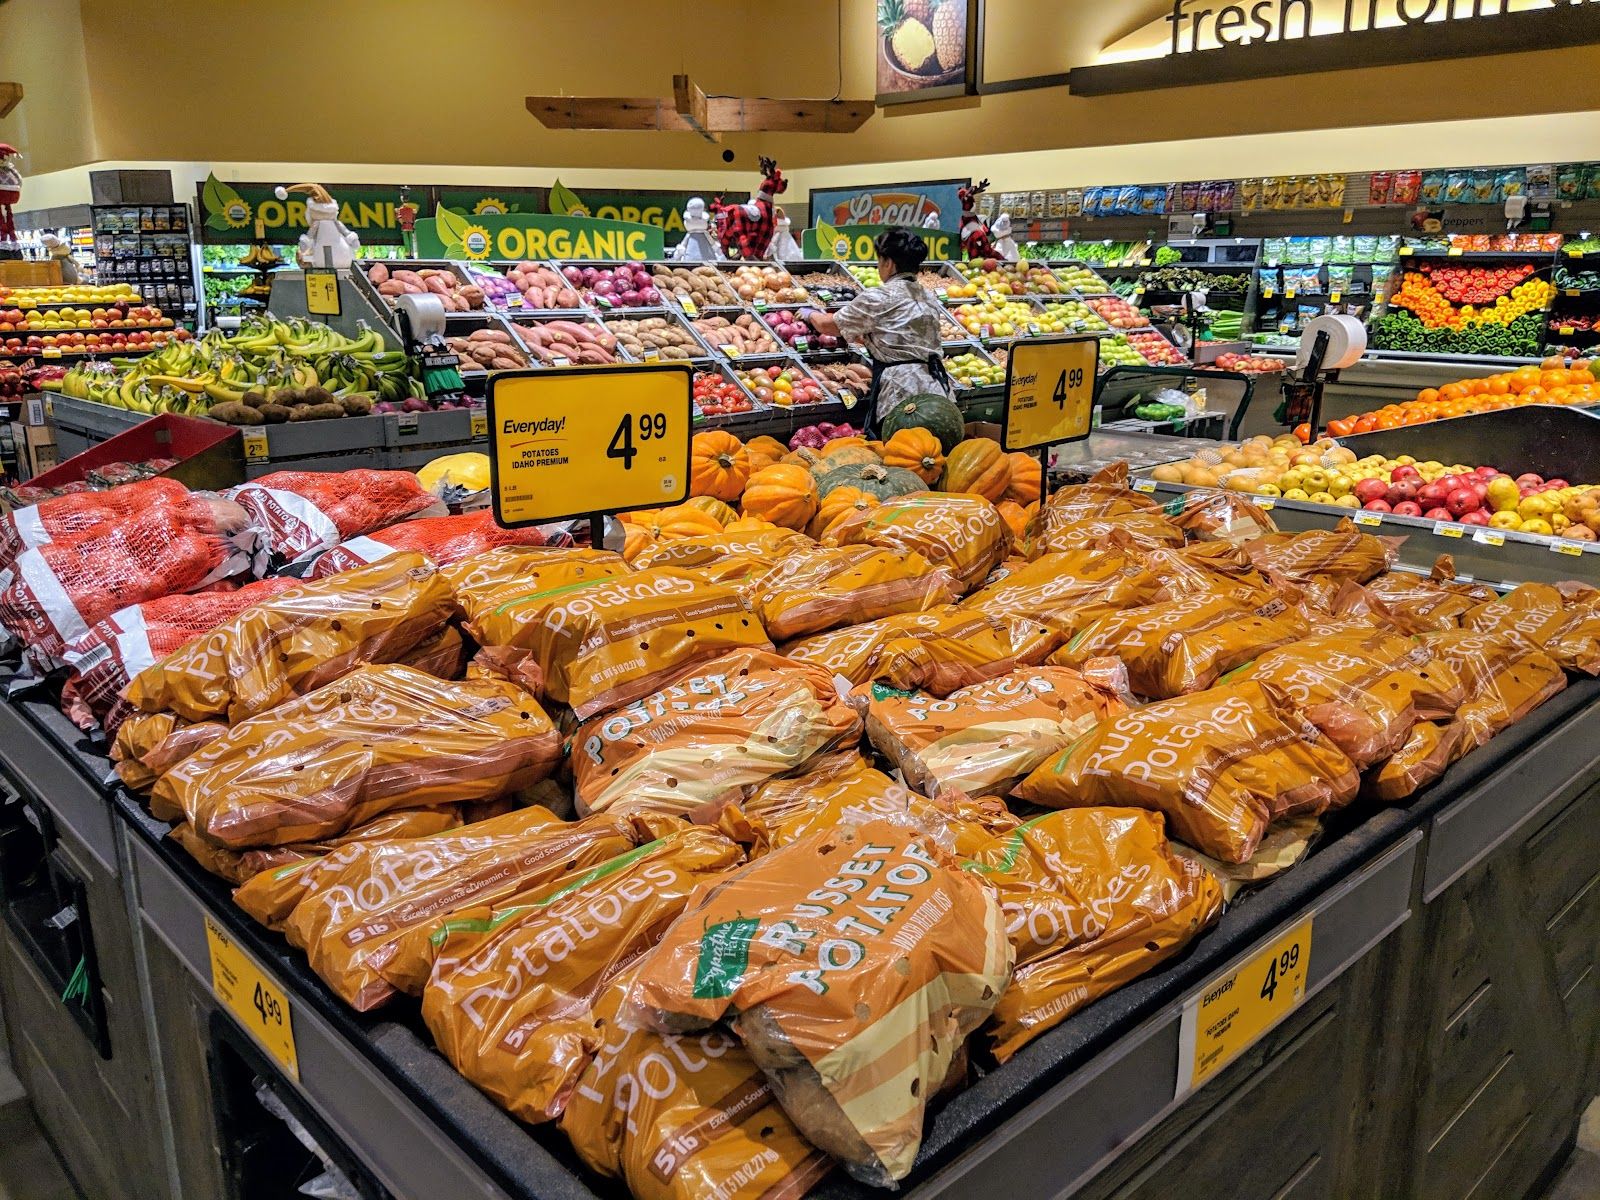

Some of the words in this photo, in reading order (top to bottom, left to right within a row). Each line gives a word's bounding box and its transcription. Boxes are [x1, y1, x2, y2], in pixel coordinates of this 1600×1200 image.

[1165, 0, 1313, 56] fresh
[257, 200, 420, 230] ORANI
[846, 193, 927, 227] Local
[1443, 216, 1485, 227] peppers
[497, 227, 648, 261] ORGANIC
[503, 416, 566, 436] Everyday!
[512, 459, 535, 469] IDAHO
[536, 457, 569, 467] PREMIUM
[521, 448, 559, 459] POTATOES
[524, 851, 546, 867] Good
[545, 840, 570, 858] Source
[402, 902, 439, 923] Excellent
[438, 889, 466, 908] Source
[465, 883, 476, 894] of
[474, 873, 504, 891] Vitamin
[503, 868, 511, 878] C
[759, 841, 897, 956] RUSSET
[346, 926, 366, 946] 5
[367, 919, 390, 938] lb
[890, 921, 921, 953] WASH
[609, 952, 637, 976] Vitamin
[636, 945, 644, 956] C
[504, 1029, 525, 1049] 5
[709, 1099, 748, 1130] Excellent
[653, 1149, 677, 1177] 5
[672, 1132, 700, 1155] lb
[726, 1176, 738, 1193] 5
[731, 1170, 749, 1188] LB
